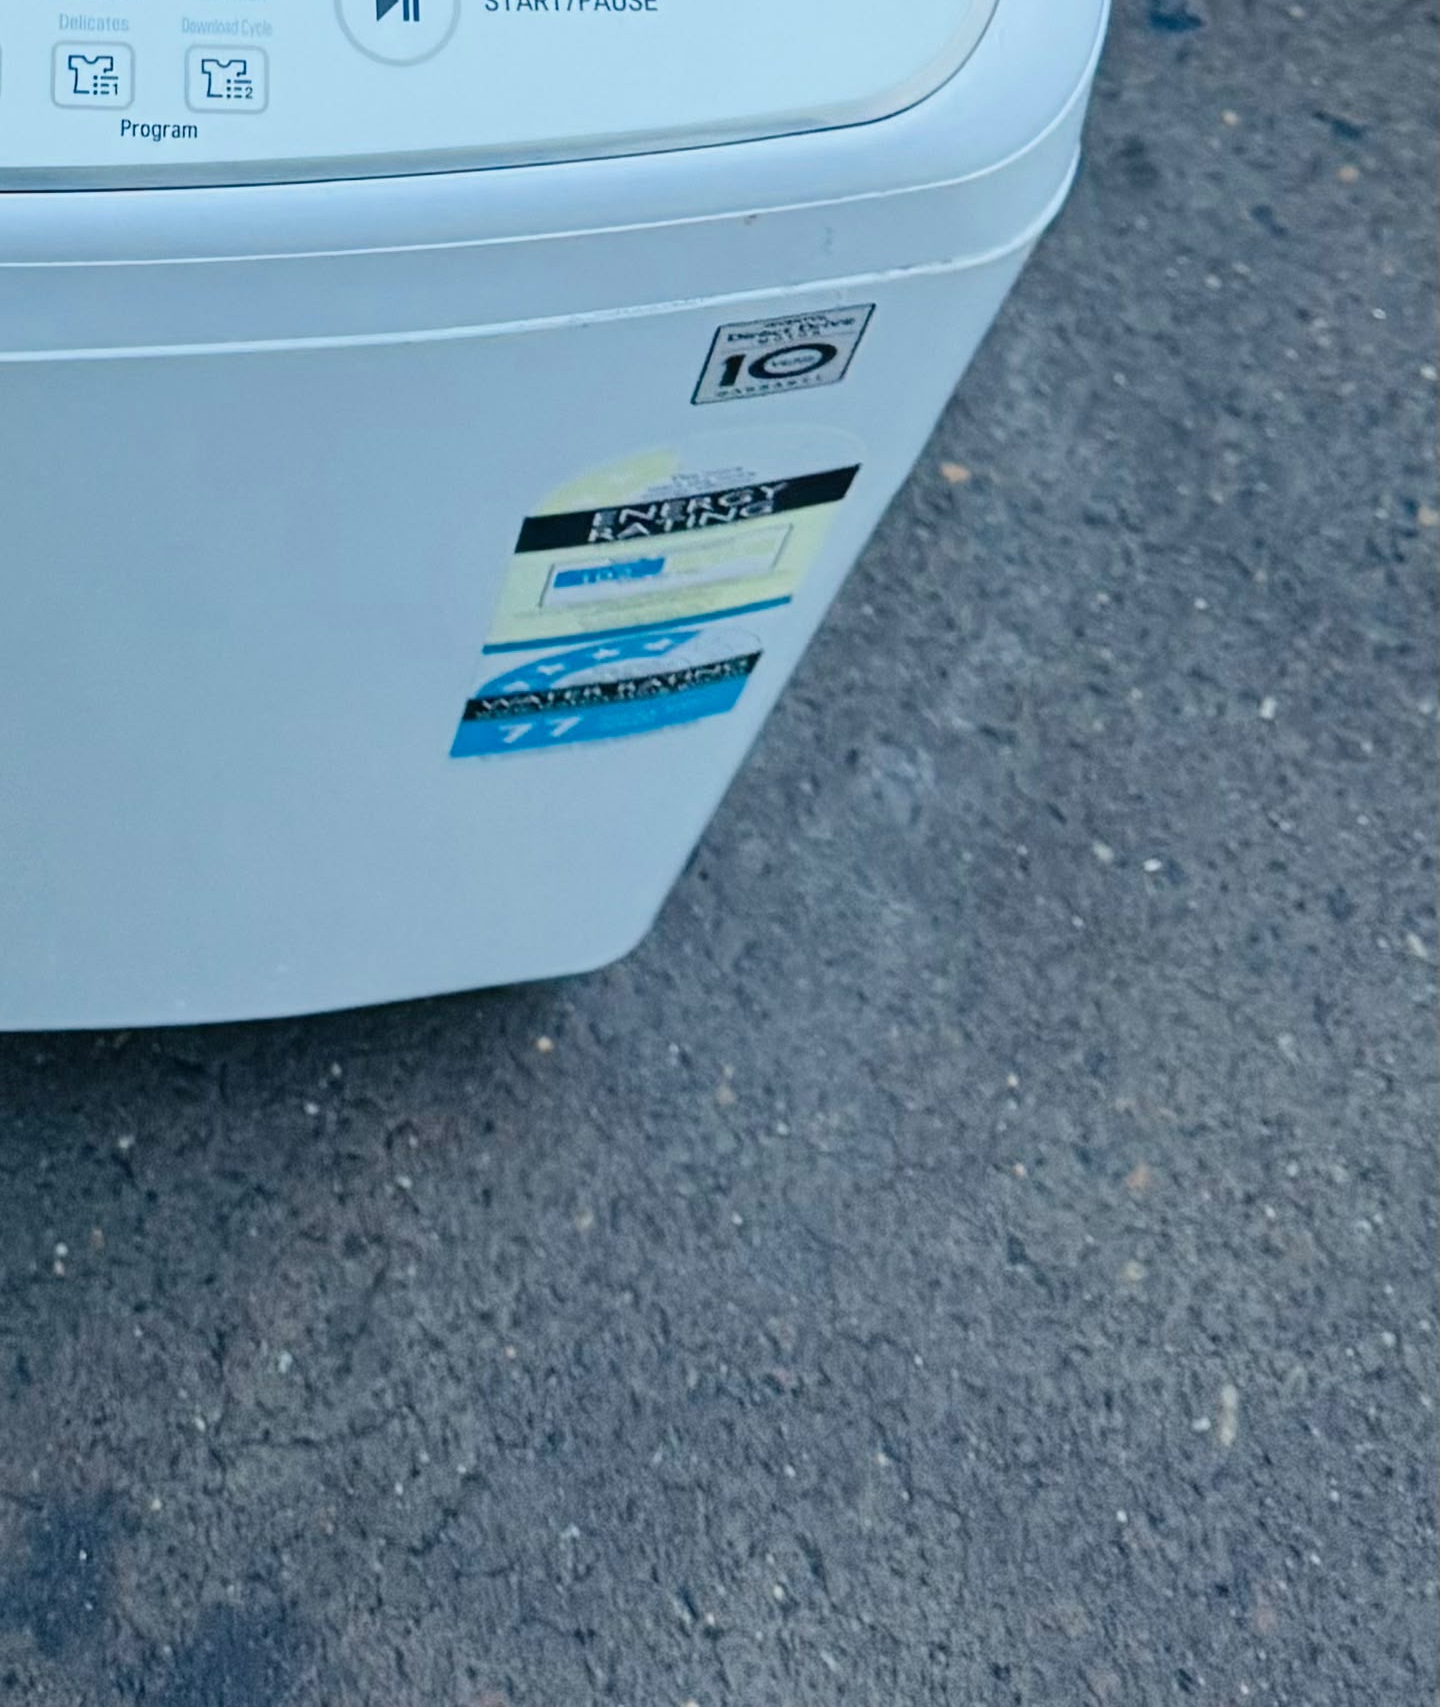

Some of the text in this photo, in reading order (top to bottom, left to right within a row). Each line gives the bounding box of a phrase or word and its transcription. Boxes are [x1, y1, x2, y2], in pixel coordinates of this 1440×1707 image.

[59, 13, 130, 32] Delicates
[181, 17, 273, 39] Download Cycle
[120, 119, 198, 142] Program
[718, 343, 838, 387] 10
[592, 482, 788, 527] ENERGY
